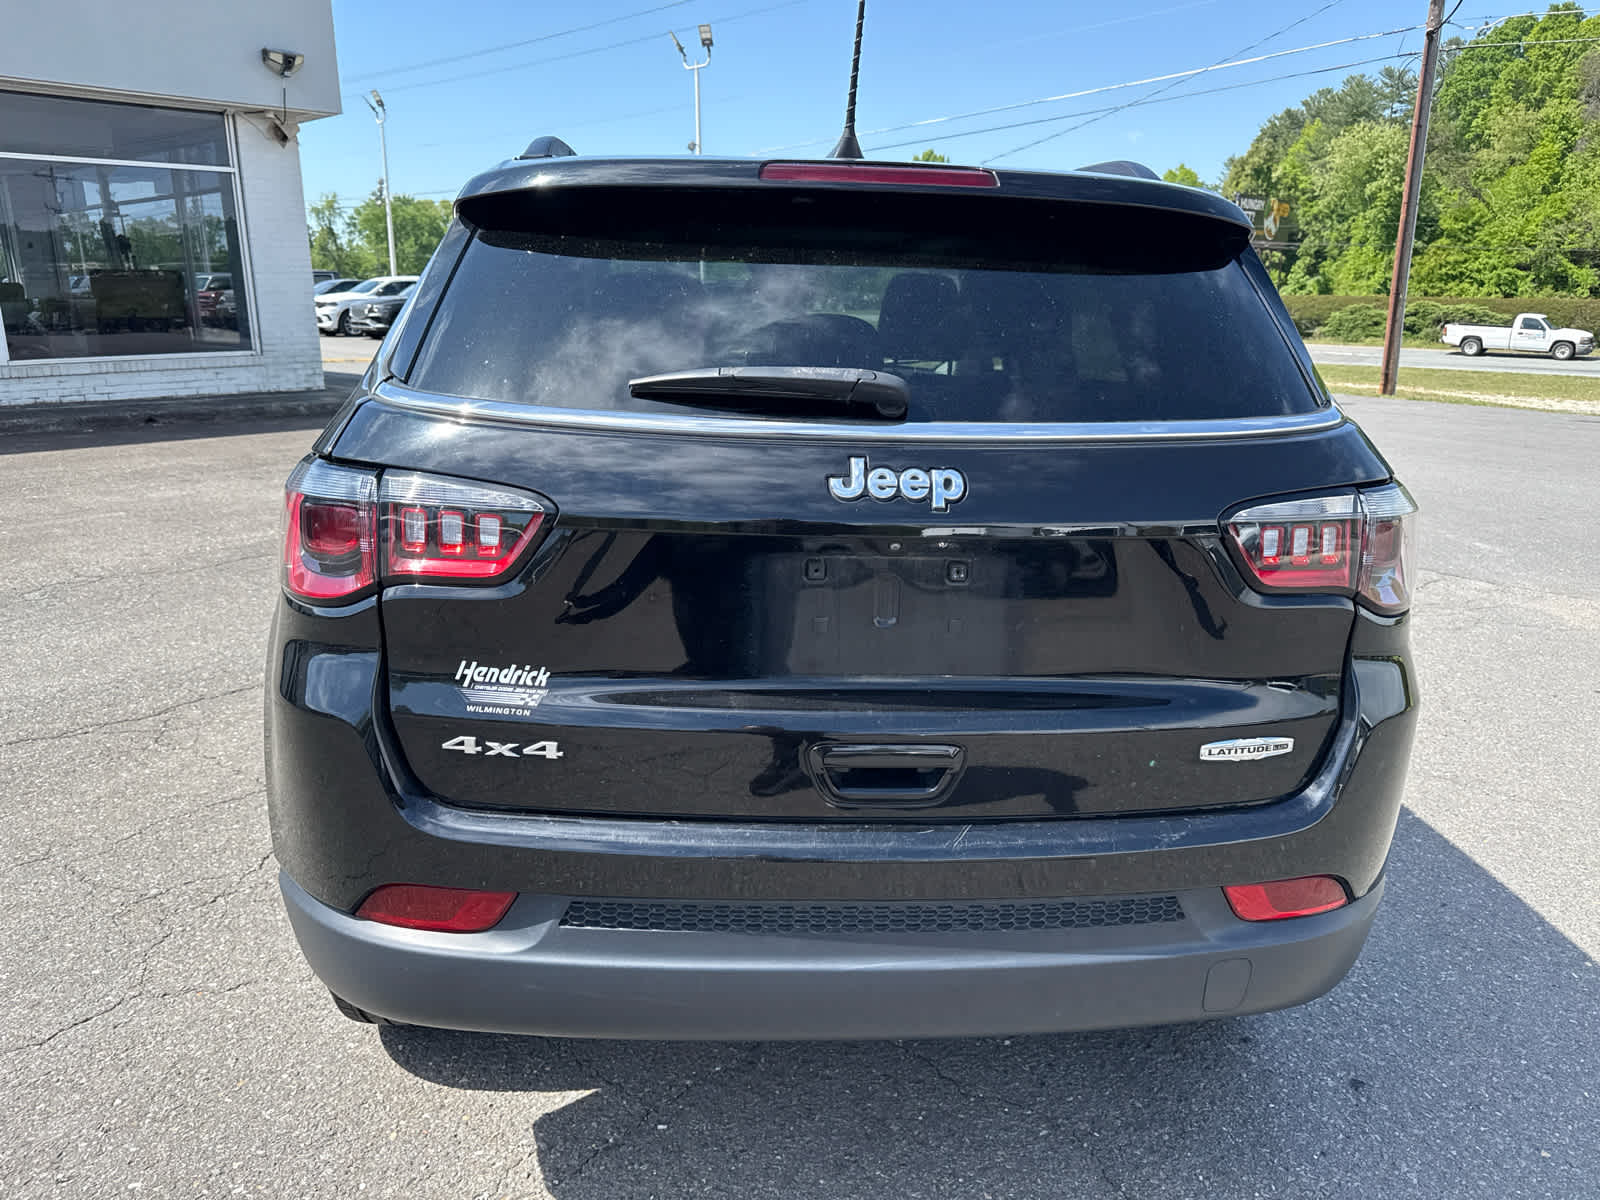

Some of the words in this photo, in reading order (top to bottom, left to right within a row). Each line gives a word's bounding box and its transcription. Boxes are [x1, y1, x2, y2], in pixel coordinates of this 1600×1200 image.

[828, 456, 965, 508] Jeep
[455, 660, 550, 687] Hendrick
[466, 705, 531, 716] WILMINGTON
[441, 735, 564, 759] 4x4
[1207, 744, 1273, 756] LATITUDE
